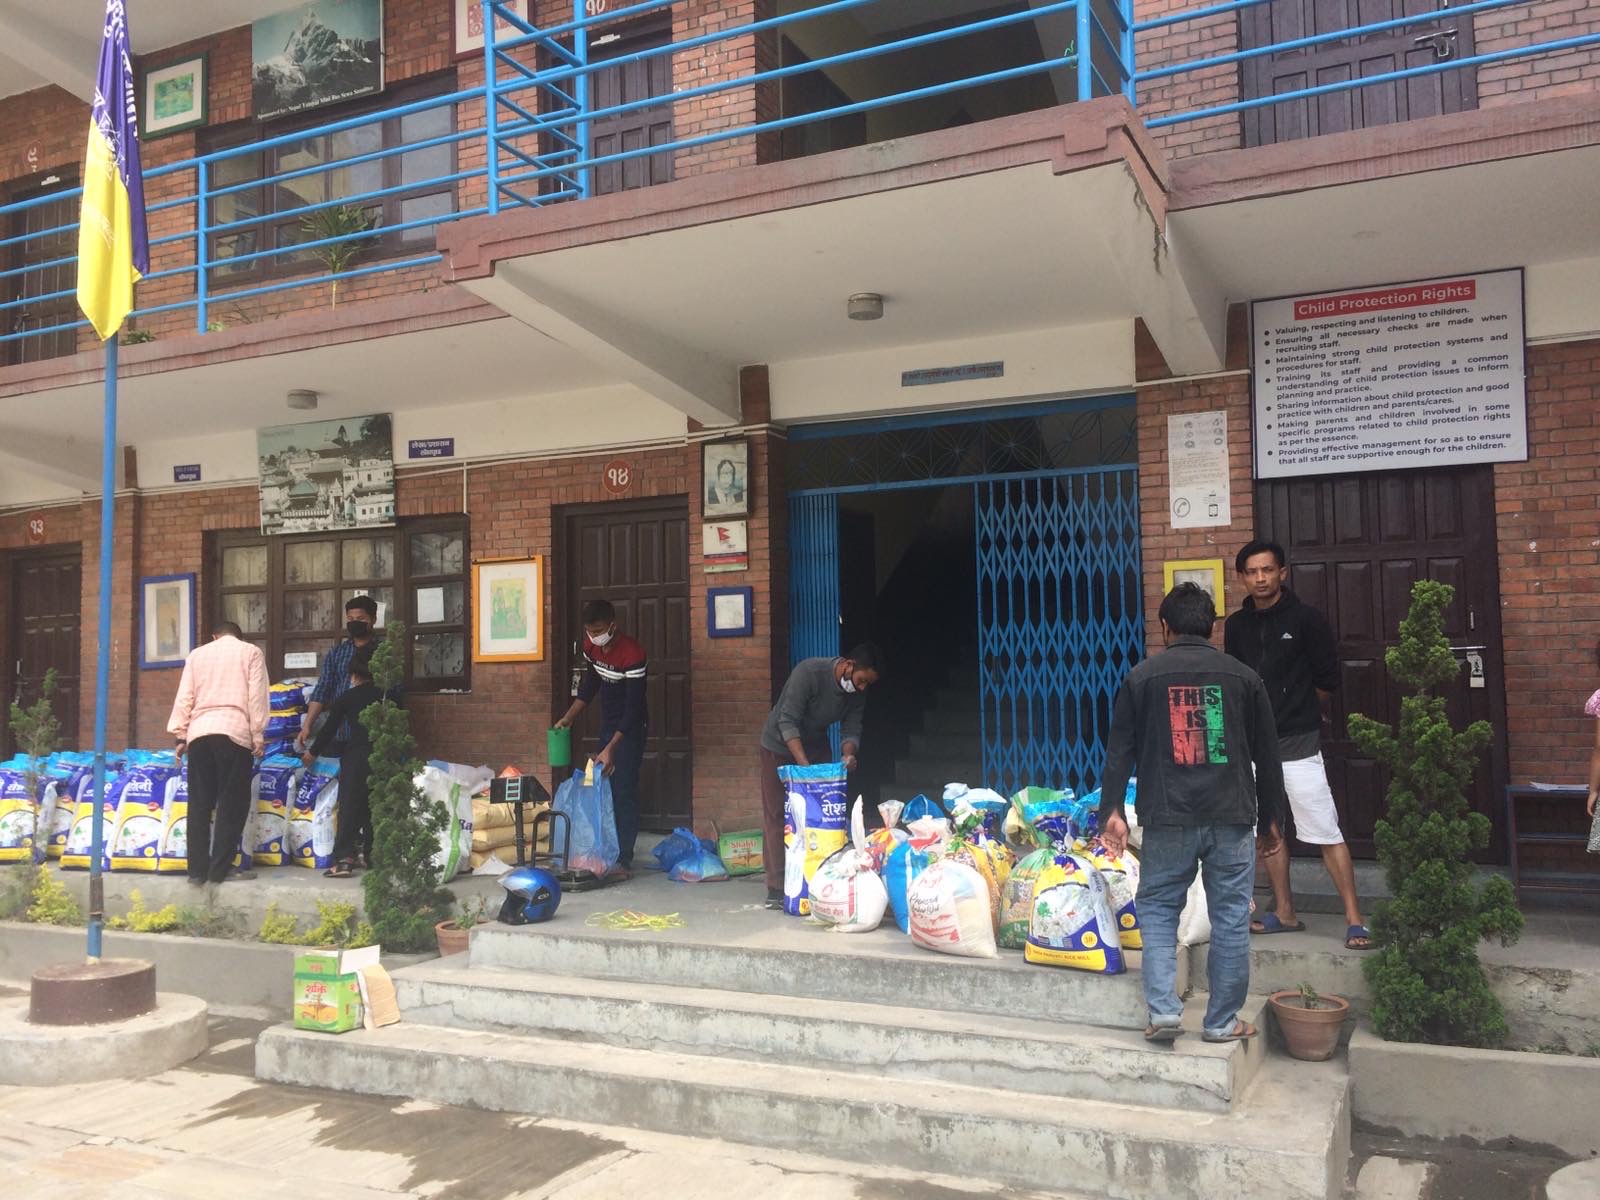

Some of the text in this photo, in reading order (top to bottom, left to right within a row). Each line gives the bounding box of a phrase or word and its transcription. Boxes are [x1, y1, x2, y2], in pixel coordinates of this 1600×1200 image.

[1298, 286, 1471, 315] Child Protection Rights
[1275, 307, 1470, 335] Valuing, respecting and listening to children.
[1275, 335, 1313, 345] Ensuring
[1337, 328, 1380, 338] necessary
[1387, 323, 1418, 332] checks
[1448, 317, 1474, 326] made
[1481, 313, 1508, 322] when
[1276, 341, 1340, 353] recruiting staff.
[1276, 333, 1508, 364] Maintaining strong child protection systems and
[1276, 362, 1324, 373] procedures
[1339, 358, 1361, 366] staff.
[1277, 373, 1311, 382] Training
[1398, 360, 1441, 371] providing
[1468, 354, 1508, 363] common
[1277, 379, 1339, 390] understanding
[1355, 374, 1377, 383] child
[1381, 371, 1428, 381] protection
[1432, 368, 1460, 376] issues
[1478, 363, 1509, 372] inform
[1277, 386, 1372, 401] planning and practice.
[1277, 401, 1309, 410] Sharing
[1312, 396, 1362, 406] information
[1364, 393, 1390, 401] about
[1392, 391, 1414, 399] child
[1416, 387, 1463, 398] protection
[1486, 382, 1510, 392] good
[1277, 410, 1312, 419] practice
[1313, 407, 1333, 415] with
[1335, 404, 1370, 413] children
[1372, 402, 1389, 410] and
[1277, 420, 1309, 428] Making
[1316, 417, 1348, 426] parents
[1355, 414, 1372, 422] and
[1379, 411, 1415, 420] children
[1422, 406, 1461, 416] involved
[1485, 403, 1510, 411] some
[1278, 429, 1311, 438] specific
[1314, 426, 1355, 435] programs
[1358, 422, 1390, 430] related
[1406, 418, 1428, 426] child
[1431, 415, 1479, 426] protection
[1483, 412, 1511, 421] rights
[1278, 447, 1319, 456] Providing
[1321, 444, 1359, 452] effective
[1362, 439, 1421, 450] management
[1479, 432, 1511, 440] ensure
[1289, 438, 1303, 447] per
[1347, 450, 1394, 460] supportive
[1396, 447, 1431, 456] enough
[1465, 442, 1507, 450] children.
[608, 468, 628, 486] १४
[31, 519, 44, 535] १३
[1170, 687, 1220, 706] THIS
[1186, 709, 1208, 728] IS
[1172, 731, 1229, 764] ME
